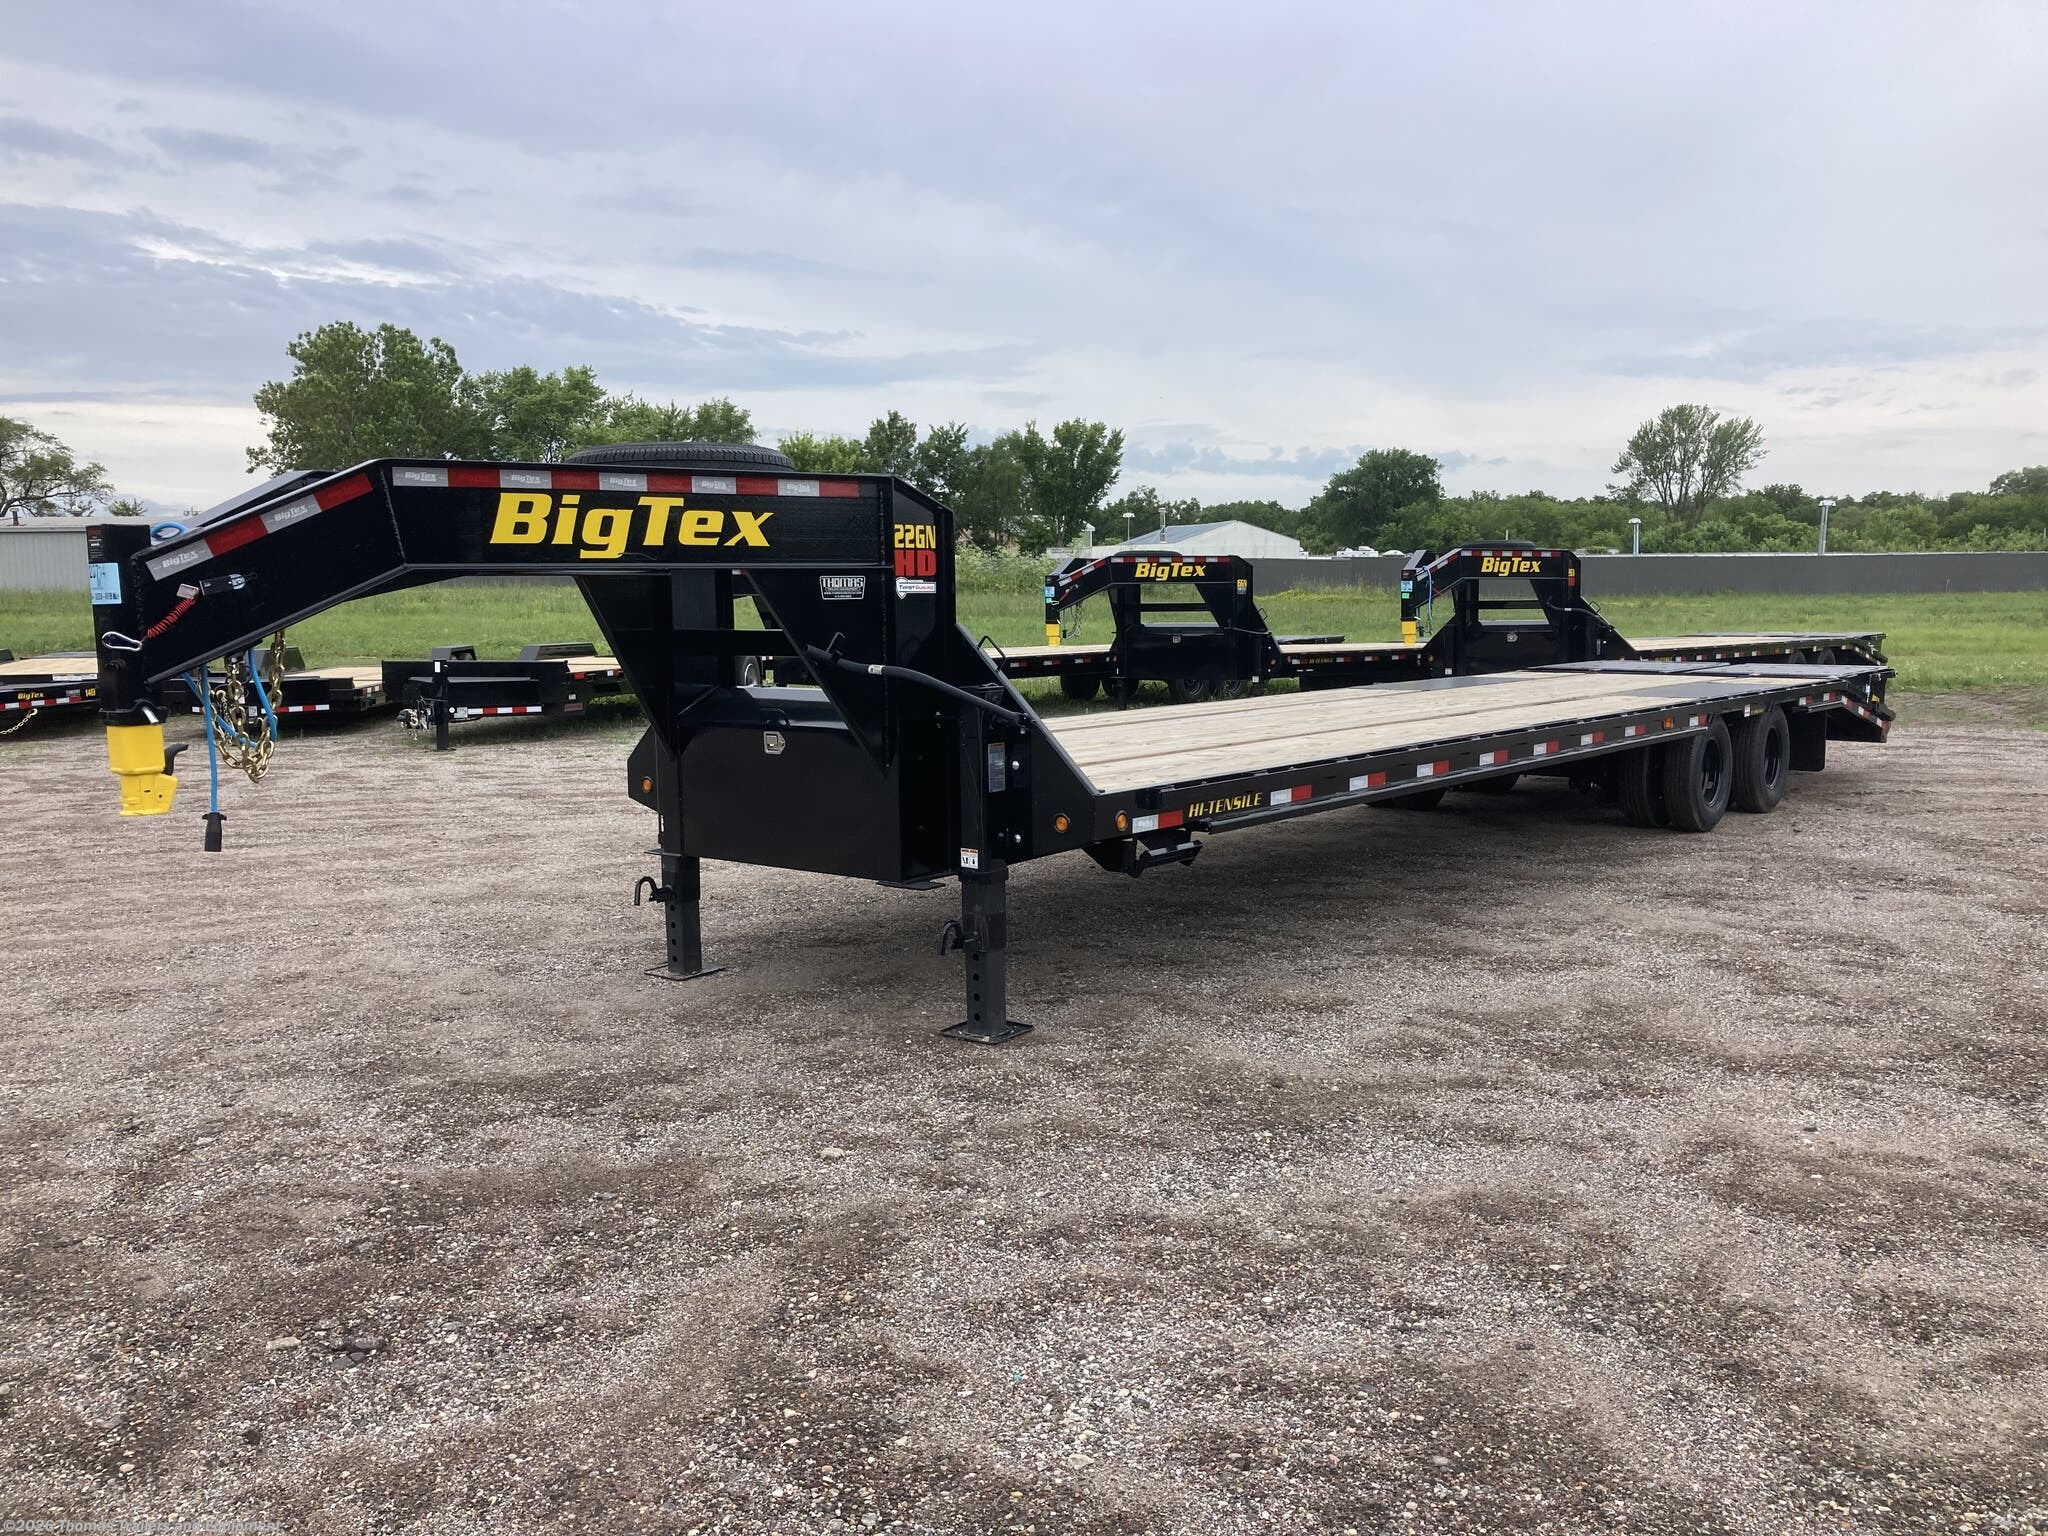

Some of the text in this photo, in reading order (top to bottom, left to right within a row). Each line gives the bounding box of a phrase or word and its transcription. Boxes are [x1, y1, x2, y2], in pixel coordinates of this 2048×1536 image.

[489, 492, 775, 559] BigTex
[894, 523, 937, 549] 22GN
[894, 549, 937, 577] HD
[1135, 562, 1207, 581] BigTex
[1481, 557, 1542, 577] BigTex
[822, 577, 864, 588] THOMAS
[1188, 791, 1263, 818] HI-TENSILE
